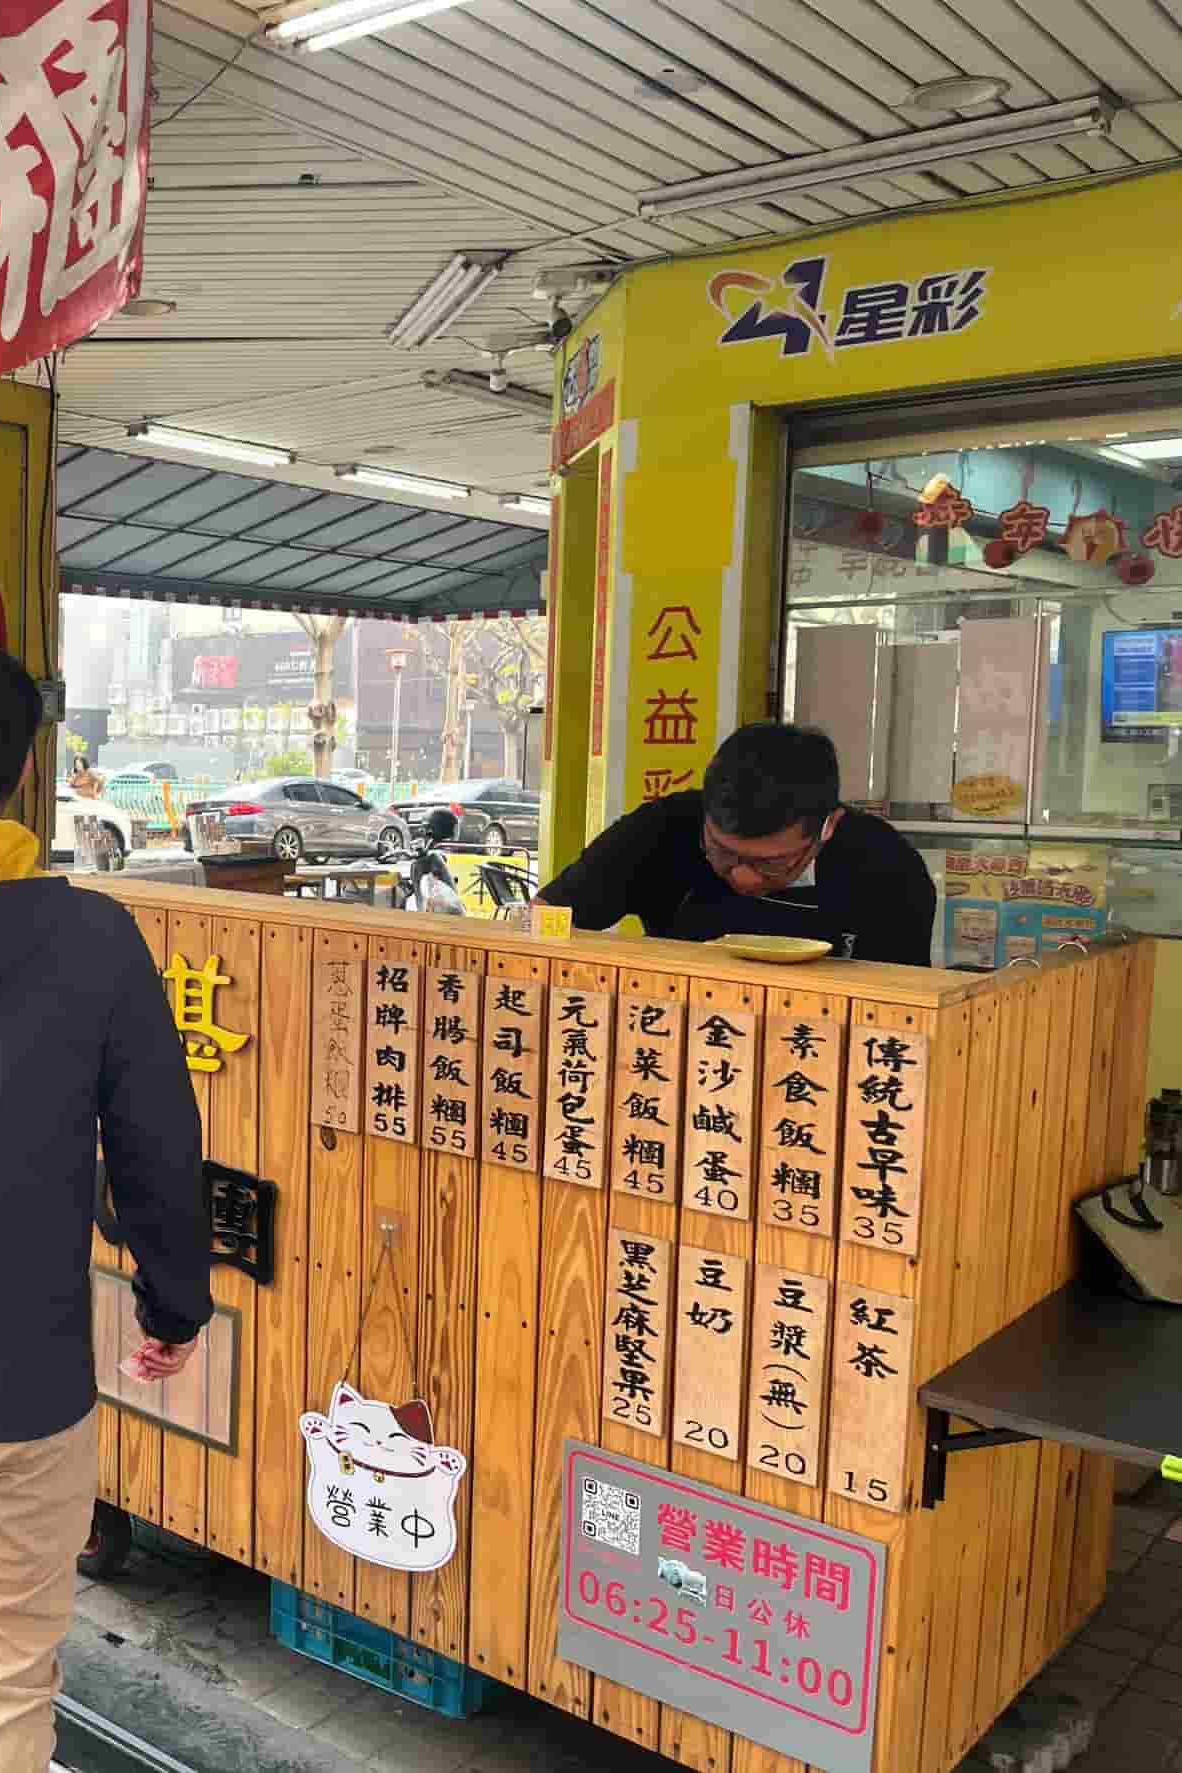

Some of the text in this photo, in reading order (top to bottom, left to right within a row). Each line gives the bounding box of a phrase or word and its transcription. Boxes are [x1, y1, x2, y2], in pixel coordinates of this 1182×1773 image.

[708, 256, 990, 358] 4星彩
[371, 965, 409, 1112] 招牌肉排
[429, 973, 471, 1126] 香腸飯糰
[489, 984, 532, 1140] 起司飯糰
[553, 996, 598, 1157] 元氣荷包蛋
[374, 1113, 406, 1136] 55
[623, 1005, 671, 1170] 泡菜飯糰
[693, 1015, 747, 1185] 金沙鹹蛋
[770, 1023, 828, 1200] 素食飯糰
[431, 1127, 467, 1150] 55
[491, 1141, 529, 1163] 45
[849, 1036, 918, 1218] 傳統古早味
[553, 1156, 592, 1180] 45
[624, 1170, 665, 1195] 45
[694, 1185, 740, 1211] 40
[772, 1199, 821, 1228] 35
[852, 1216, 904, 1247] 35
[611, 1239, 659, 1401] 黑芝麻堅果
[685, 1259, 734, 1335] 豆奶
[845, 1298, 899, 1379] 紅茶
[611, 1397, 653, 1427] 25
[684, 1420, 731, 1450] 20
[759, 1445, 808, 1475] 20
[844, 1471, 889, 1502] 15
[326, 1484, 435, 1549] 營業中
[657, 1503, 852, 1613] 營業時間
[578, 1570, 854, 1707] 06:25-11:00
